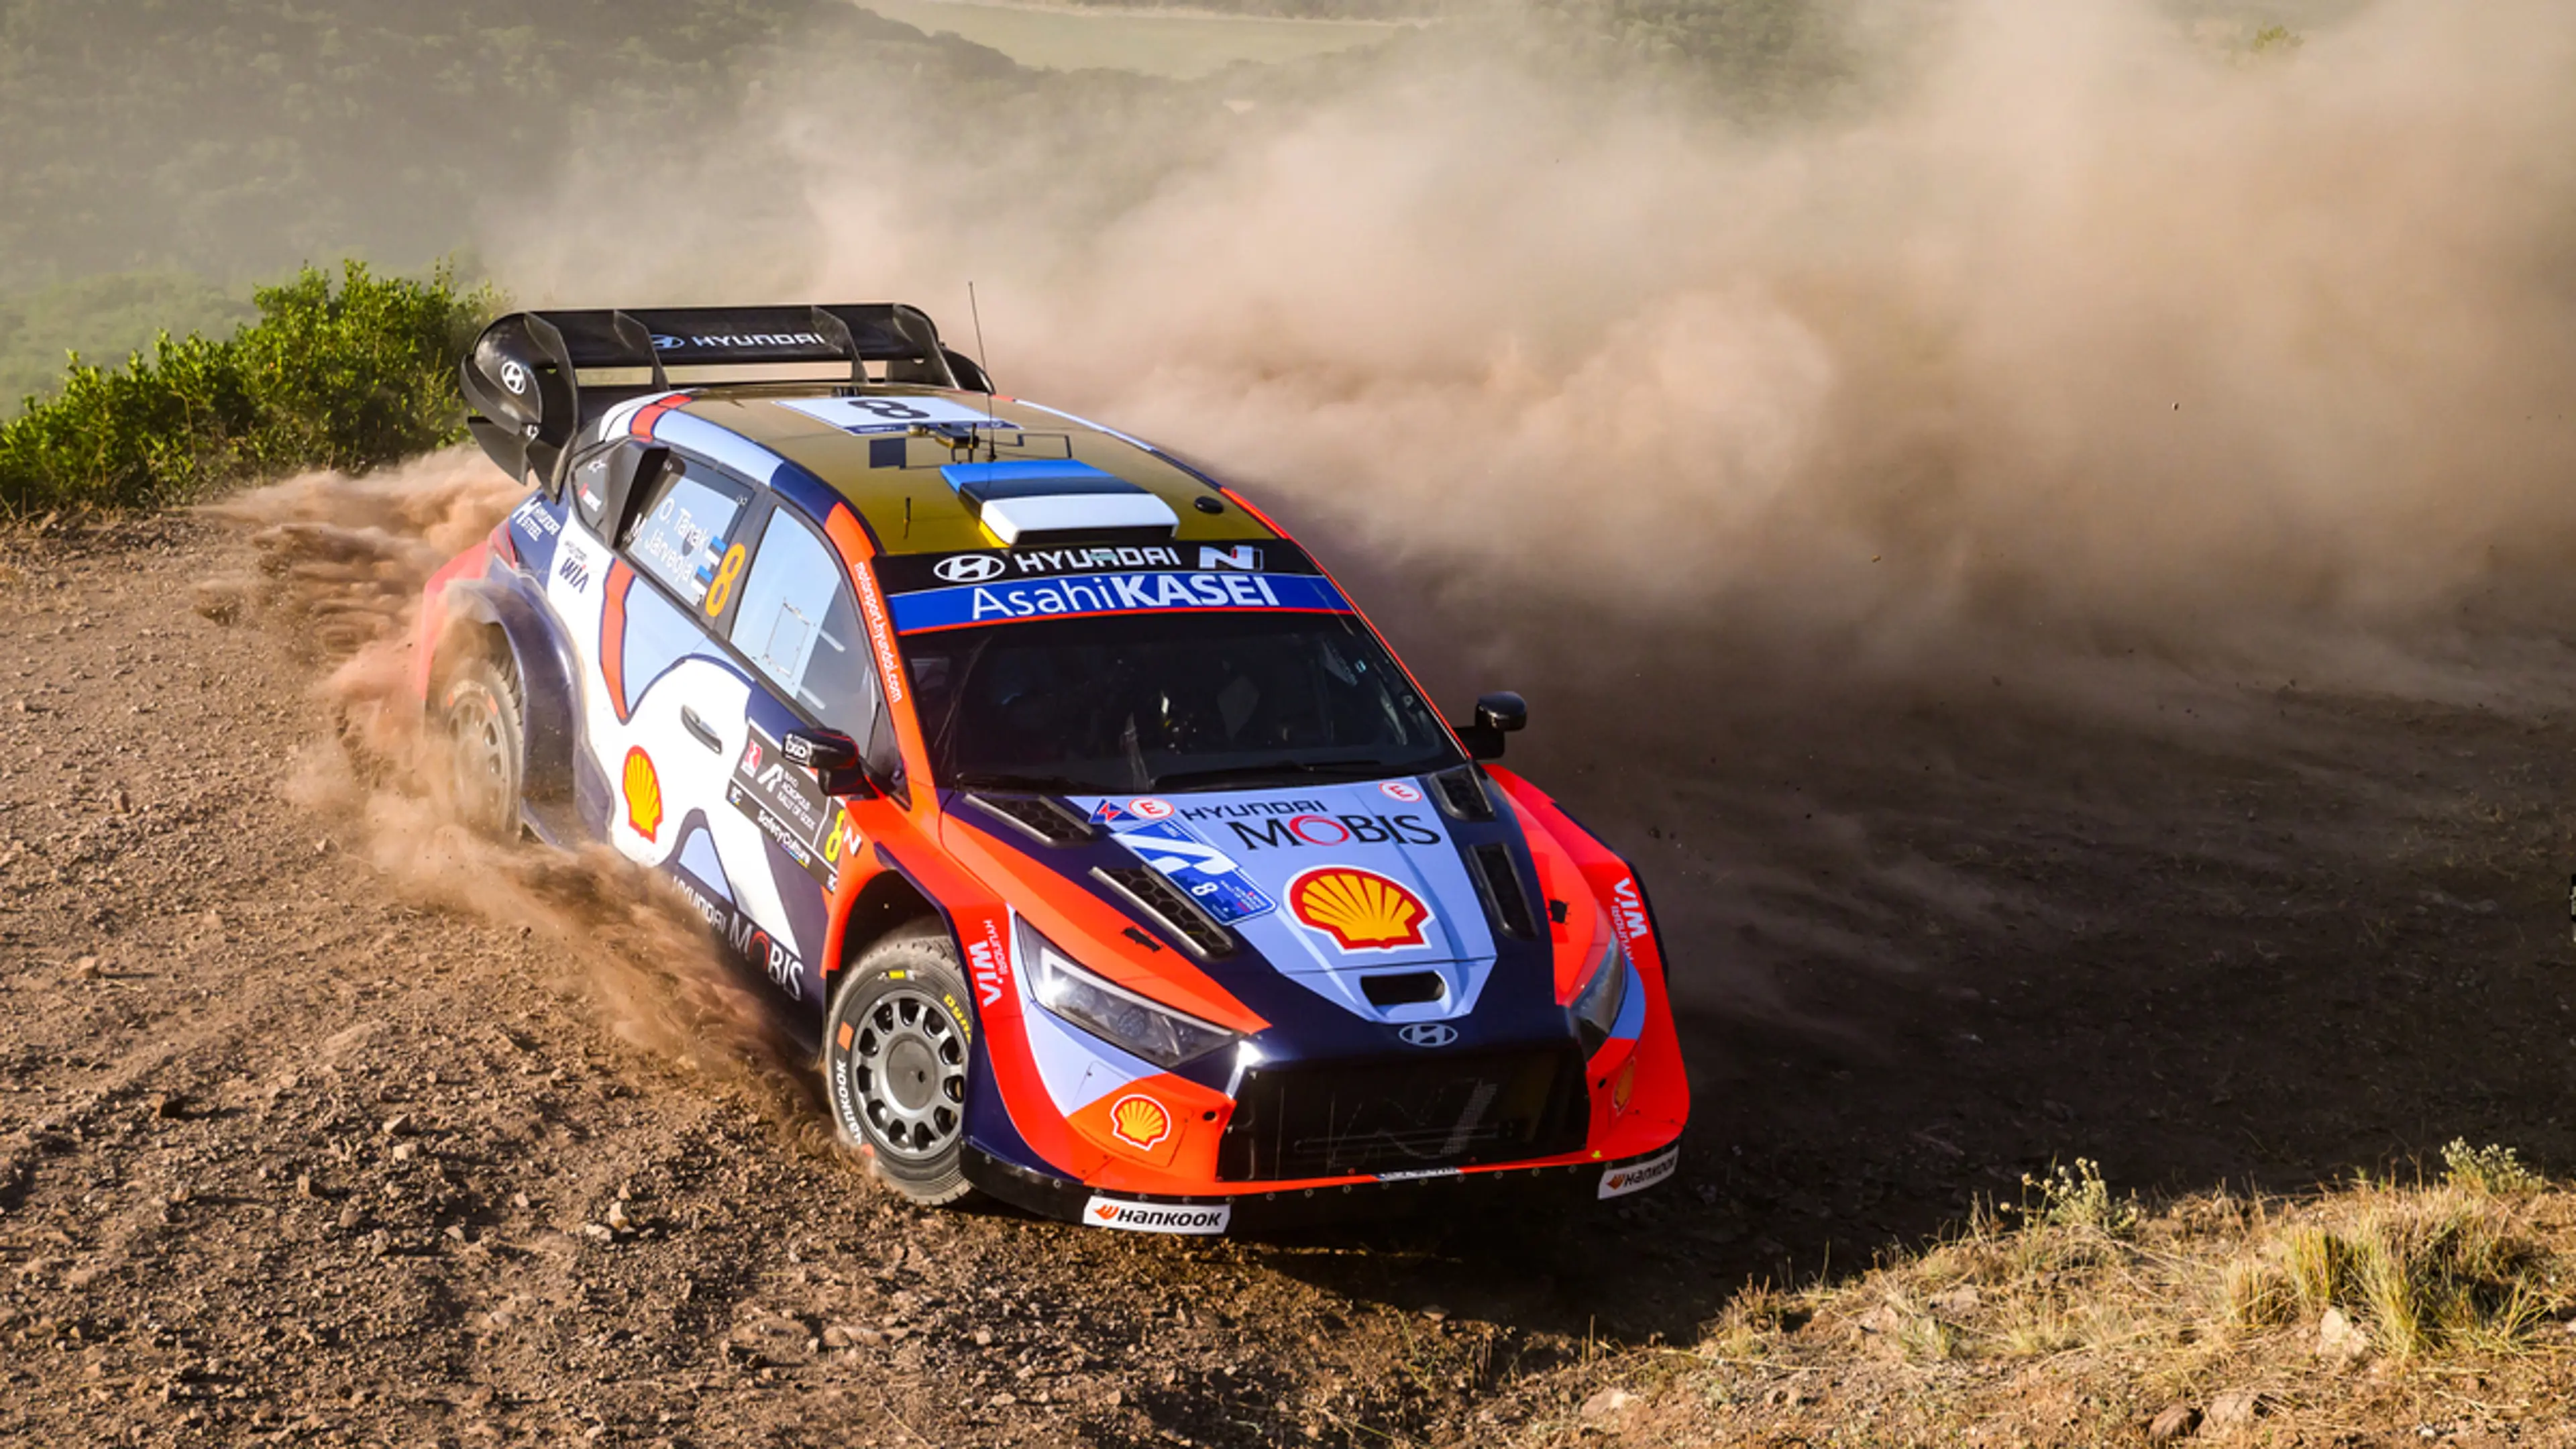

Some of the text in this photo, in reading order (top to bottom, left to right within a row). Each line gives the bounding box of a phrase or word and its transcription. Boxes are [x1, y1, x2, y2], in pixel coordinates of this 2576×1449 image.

[693, 333, 825, 346] HYUNDAI
[848, 400, 930, 419] 8
[1013, 546, 1182, 572] HYUNDAI
[706, 543, 745, 616] 8
[972, 575, 1280, 621] AsahiKASEI
[854, 561, 902, 703] motorsport.hyundai.com
[1180, 800, 1328, 821] HYUNDAI
[843, 826, 863, 857] N
[1226, 814, 1441, 850] MOBIS
[1191, 881, 1219, 896] 8
